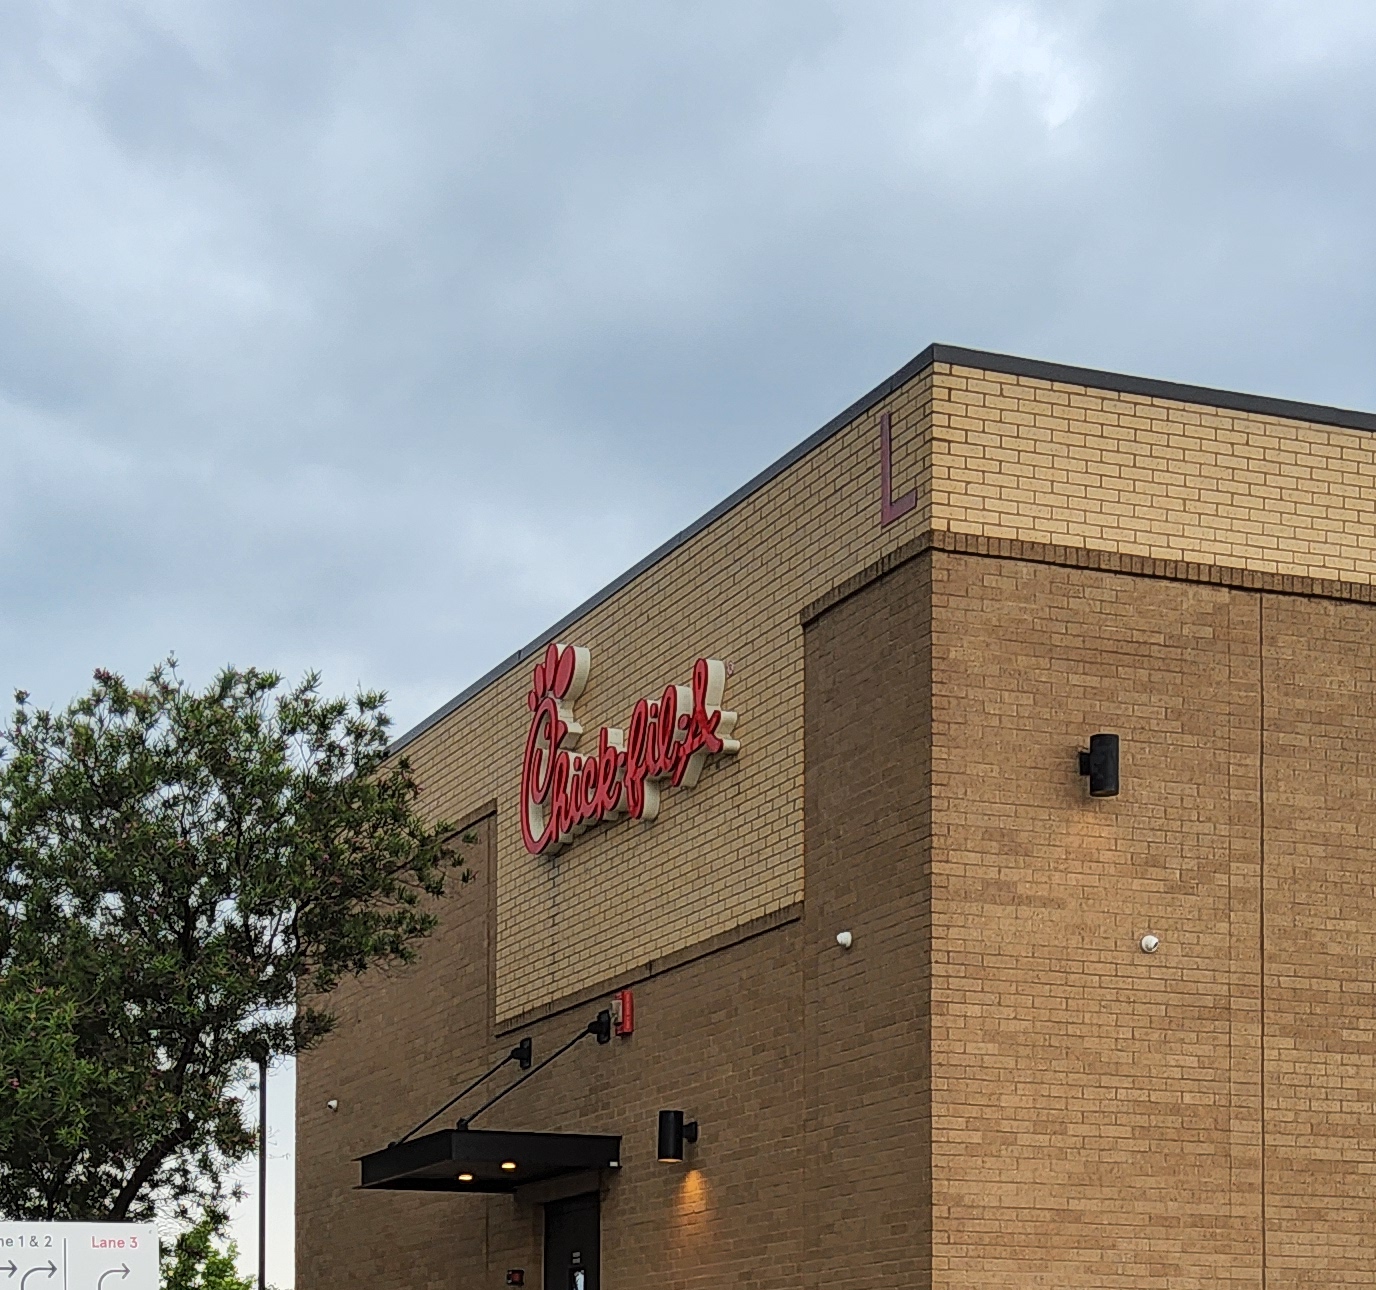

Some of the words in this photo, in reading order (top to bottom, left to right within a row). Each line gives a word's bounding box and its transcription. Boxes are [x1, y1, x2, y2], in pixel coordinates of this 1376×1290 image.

[520, 643, 726, 855] Chick-fil-A
[17, 1235, 25, 1248] 1
[29, 1235, 39, 1248] &
[43, 1235, 53, 1248] 2
[91, 1236, 126, 1249] Lane
[129, 1236, 139, 1249] 3
